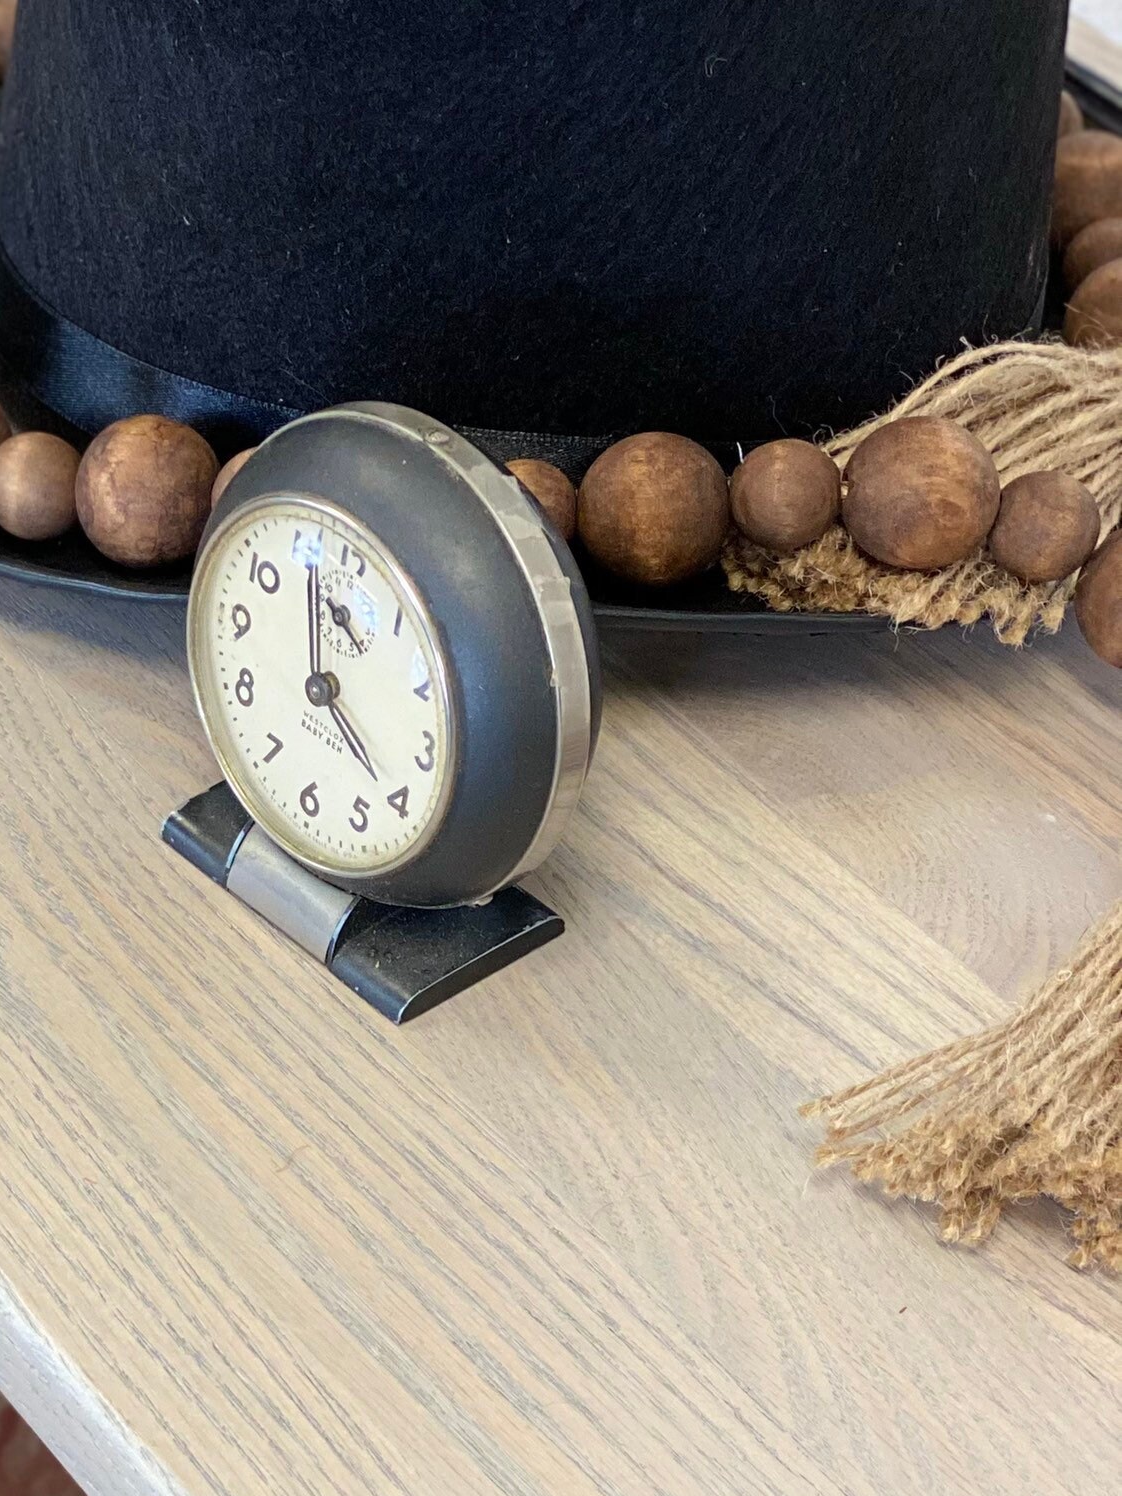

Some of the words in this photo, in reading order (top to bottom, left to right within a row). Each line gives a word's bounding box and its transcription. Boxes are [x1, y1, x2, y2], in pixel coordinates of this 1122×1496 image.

[249, 551, 281, 594] 10
[324, 583, 333, 593] 10
[232, 603, 252, 641] 9
[327, 626, 333, 635] 7
[393, 606, 403, 637] 1
[336, 638, 342, 648] 6
[349, 642, 355, 652] 5
[235, 667, 254, 708] 8
[301, 719, 324, 740] BABY
[303, 710, 344, 745] WESTCLOX
[263, 732, 284, 764] 7
[414, 730, 435, 772] 3
[300, 781, 320, 818] 6
[348, 795, 371, 833] 5
[387, 785, 410, 819] 4
